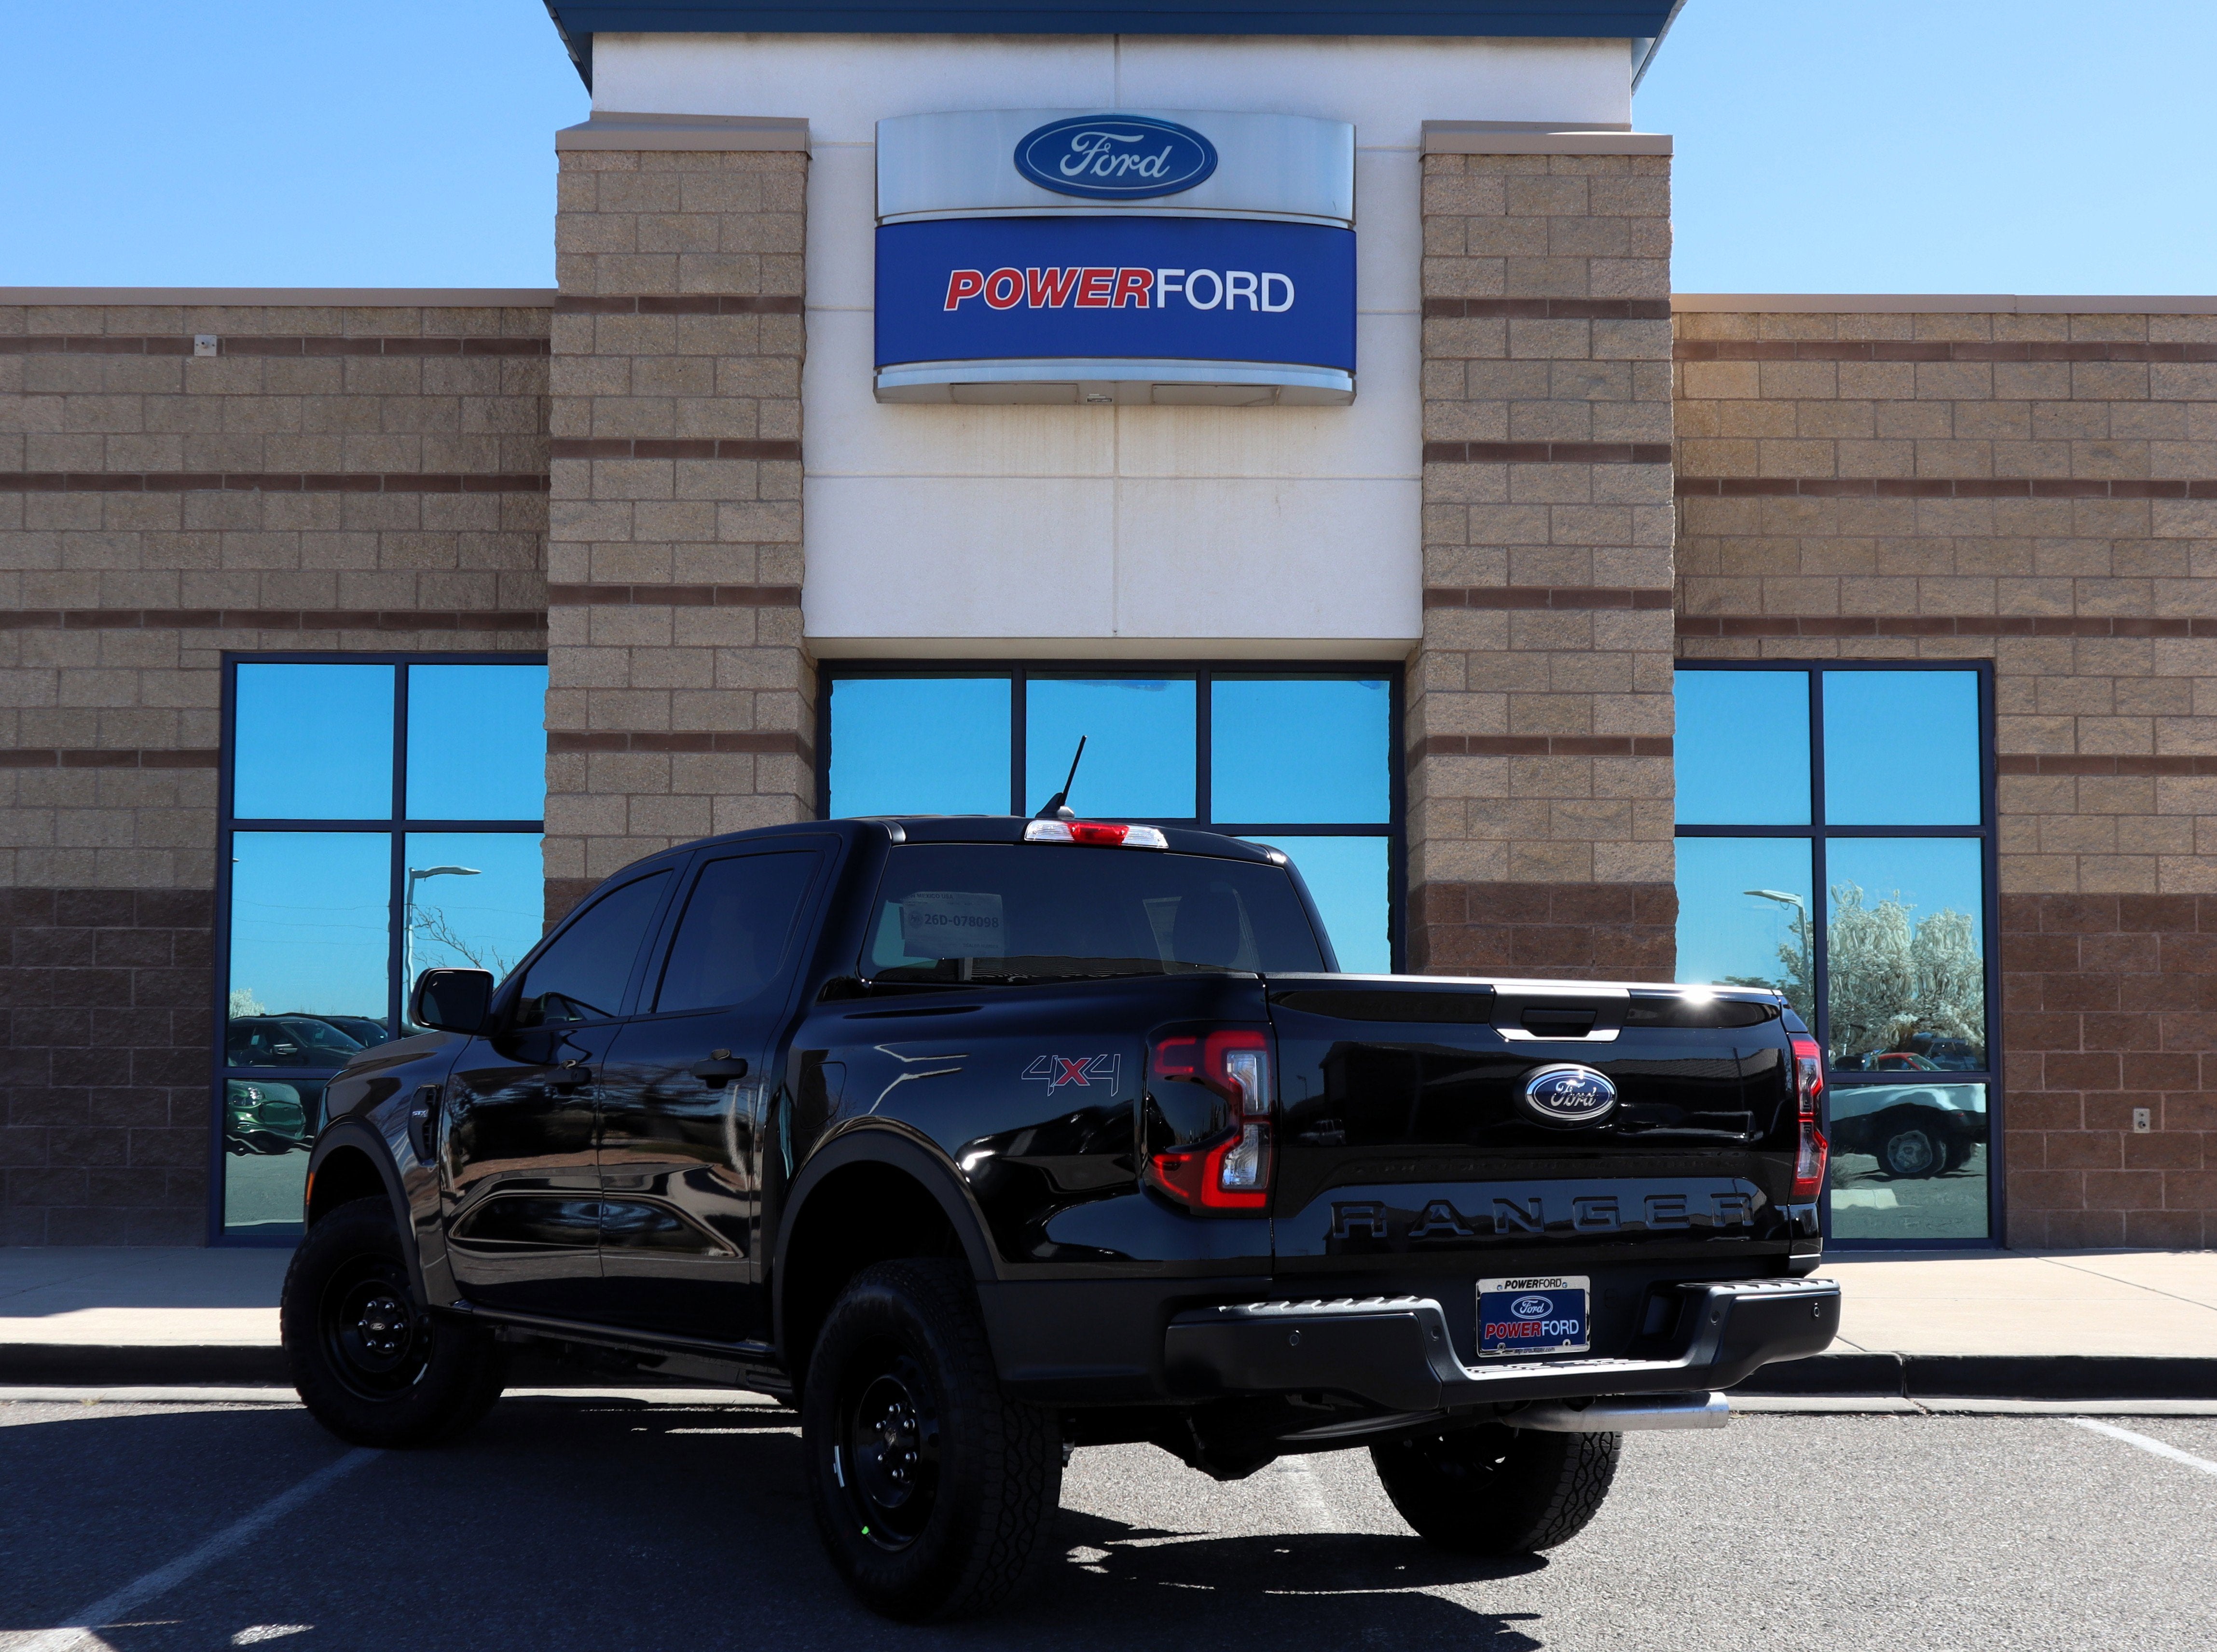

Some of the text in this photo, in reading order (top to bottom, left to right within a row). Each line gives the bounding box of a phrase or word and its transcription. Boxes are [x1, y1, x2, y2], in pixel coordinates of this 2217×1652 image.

[1060, 131, 1171, 179] Ford
[943, 267, 1295, 312] POWERFORD
[924, 914, 999, 928] 26D-078098
[1550, 1080, 1598, 1107] Ford
[1331, 1194, 1754, 1239] RANGER
[1504, 1279, 1561, 1289] POWERFORD
[1520, 1300, 1545, 1314] Ford
[1485, 1320, 1579, 1339] POWERFORD
